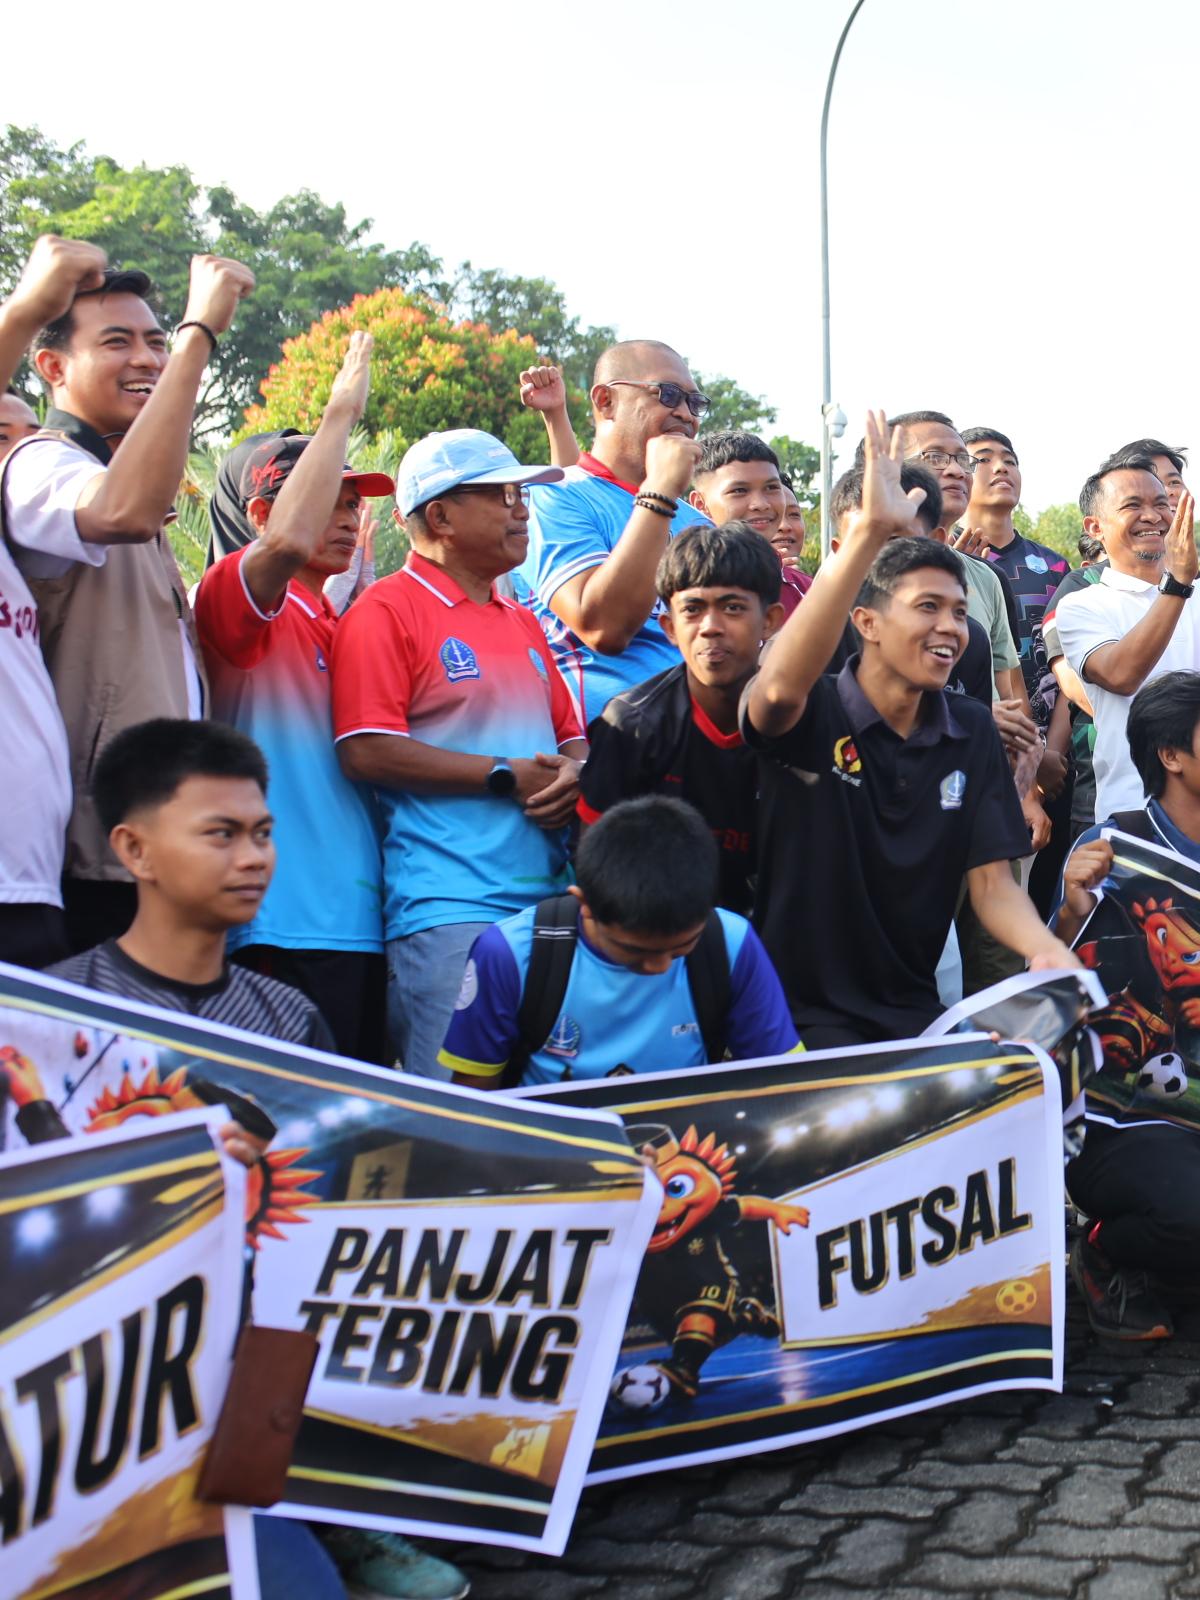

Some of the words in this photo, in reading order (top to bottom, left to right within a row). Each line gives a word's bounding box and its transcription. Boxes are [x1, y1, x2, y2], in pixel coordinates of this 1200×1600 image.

[315, 1227, 614, 1310] PANJAT
[816, 1157, 1033, 1311] FUTSAL
[299, 1300, 581, 1405] TEBING
